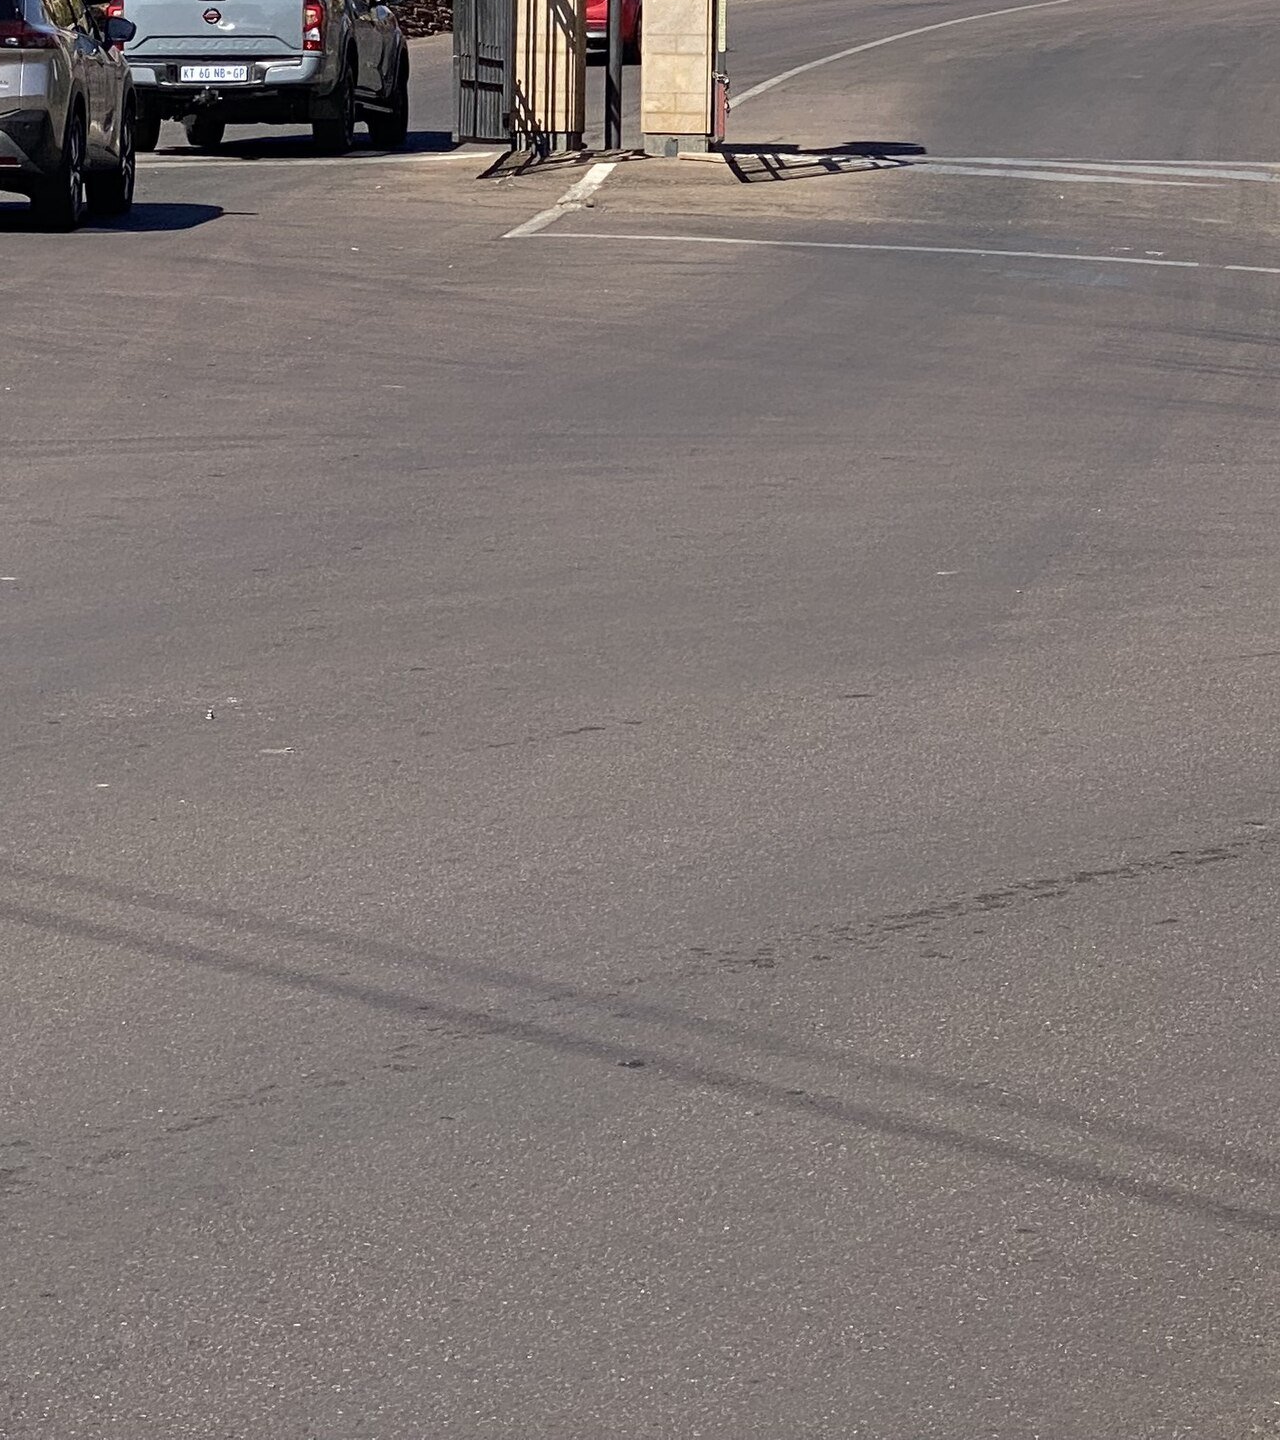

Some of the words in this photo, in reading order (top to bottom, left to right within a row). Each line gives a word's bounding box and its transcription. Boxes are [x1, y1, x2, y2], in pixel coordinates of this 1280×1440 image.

[183, 67, 195, 79] KT
[213, 67, 226, 79] NB
[233, 68, 245, 80] GP
